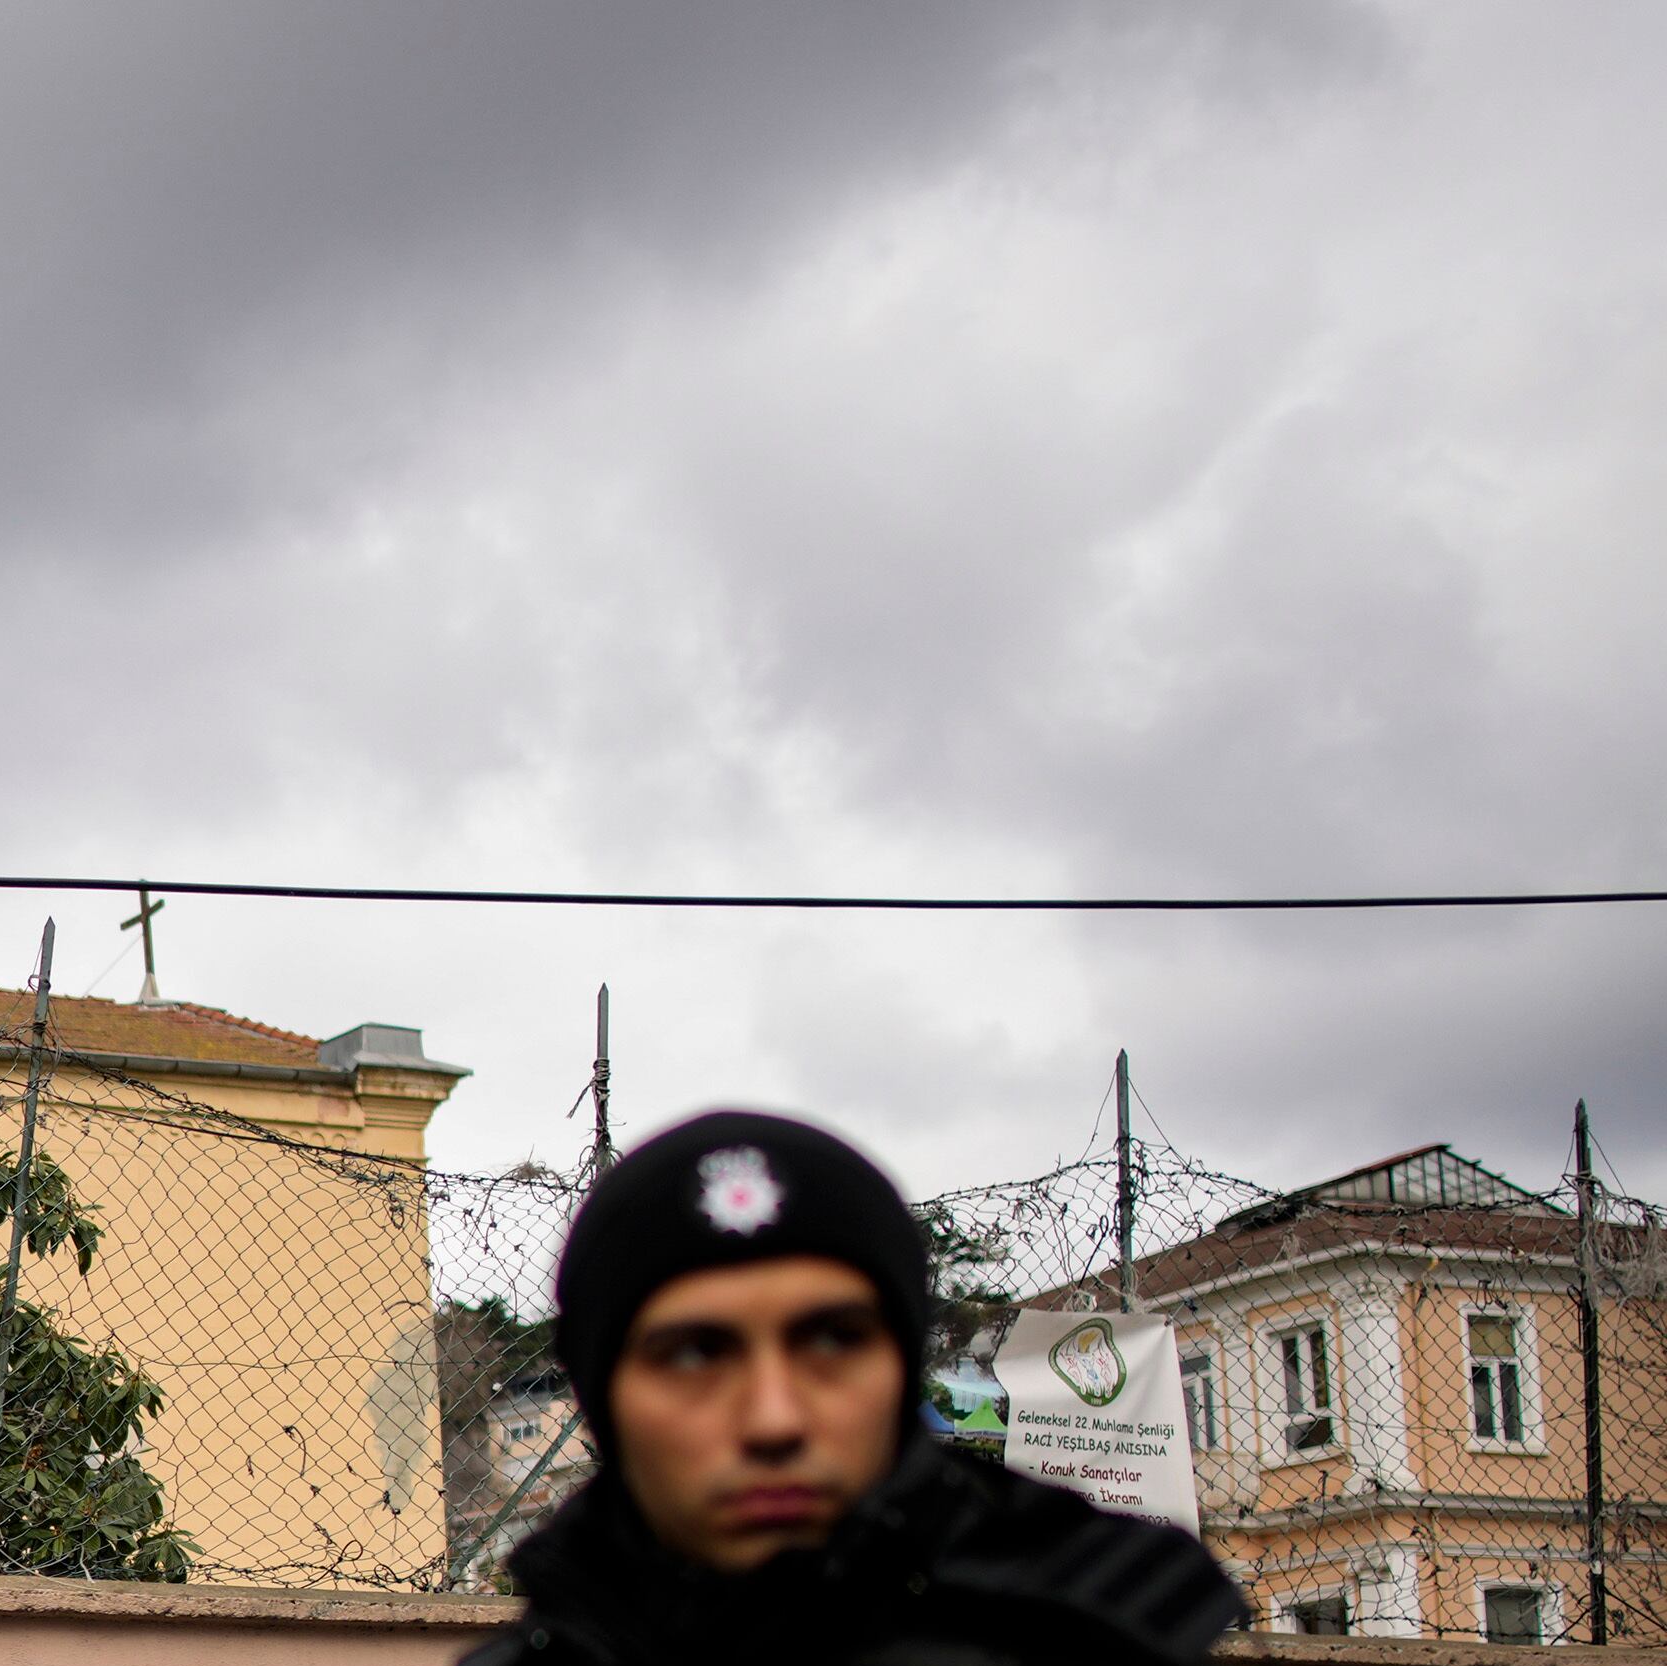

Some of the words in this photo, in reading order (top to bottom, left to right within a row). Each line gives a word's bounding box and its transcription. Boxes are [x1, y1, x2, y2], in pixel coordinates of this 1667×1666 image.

[1017, 1410, 1071, 1427] Geleneksel
[1137, 1423, 1175, 1440] Şenliği
[1024, 1432, 1052, 1446] RACİ
[1056, 1435, 1111, 1455] YEŞİLBAŞ
[1114, 1441, 1167, 1457] ANISINA
[1041, 1460, 1075, 1477] Konuk
[1080, 1465, 1143, 1485] Sanatçılar
[1099, 1487, 1143, 1506] İkramı
